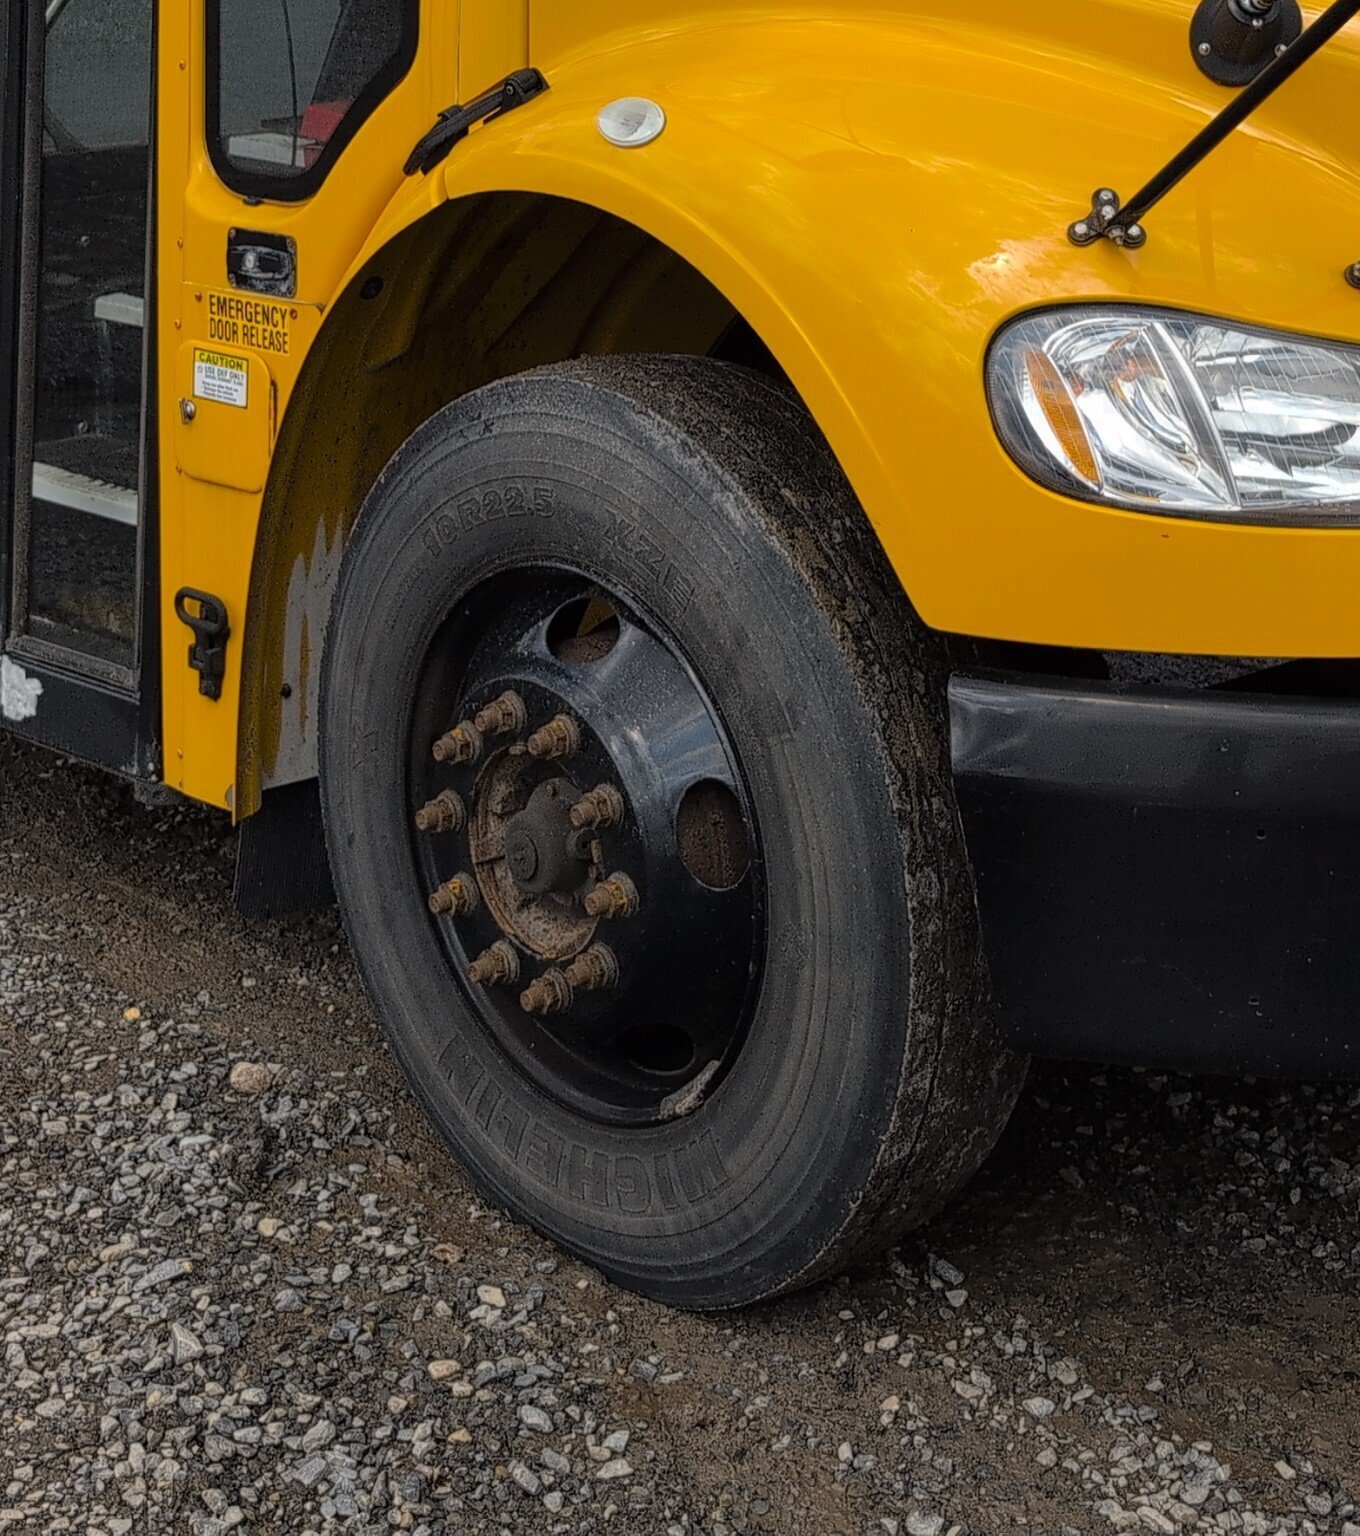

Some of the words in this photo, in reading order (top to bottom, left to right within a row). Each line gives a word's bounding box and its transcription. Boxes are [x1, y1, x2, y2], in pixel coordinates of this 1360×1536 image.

[209, 294, 288, 330] EMERGENCY
[209, 318, 239, 344] DOOR
[243, 324, 289, 355] RELEASE
[199, 352, 243, 371] CAUTION
[422, 483, 557, 560] 10R22.5
[436, 1031, 731, 1214] MICHELIN
